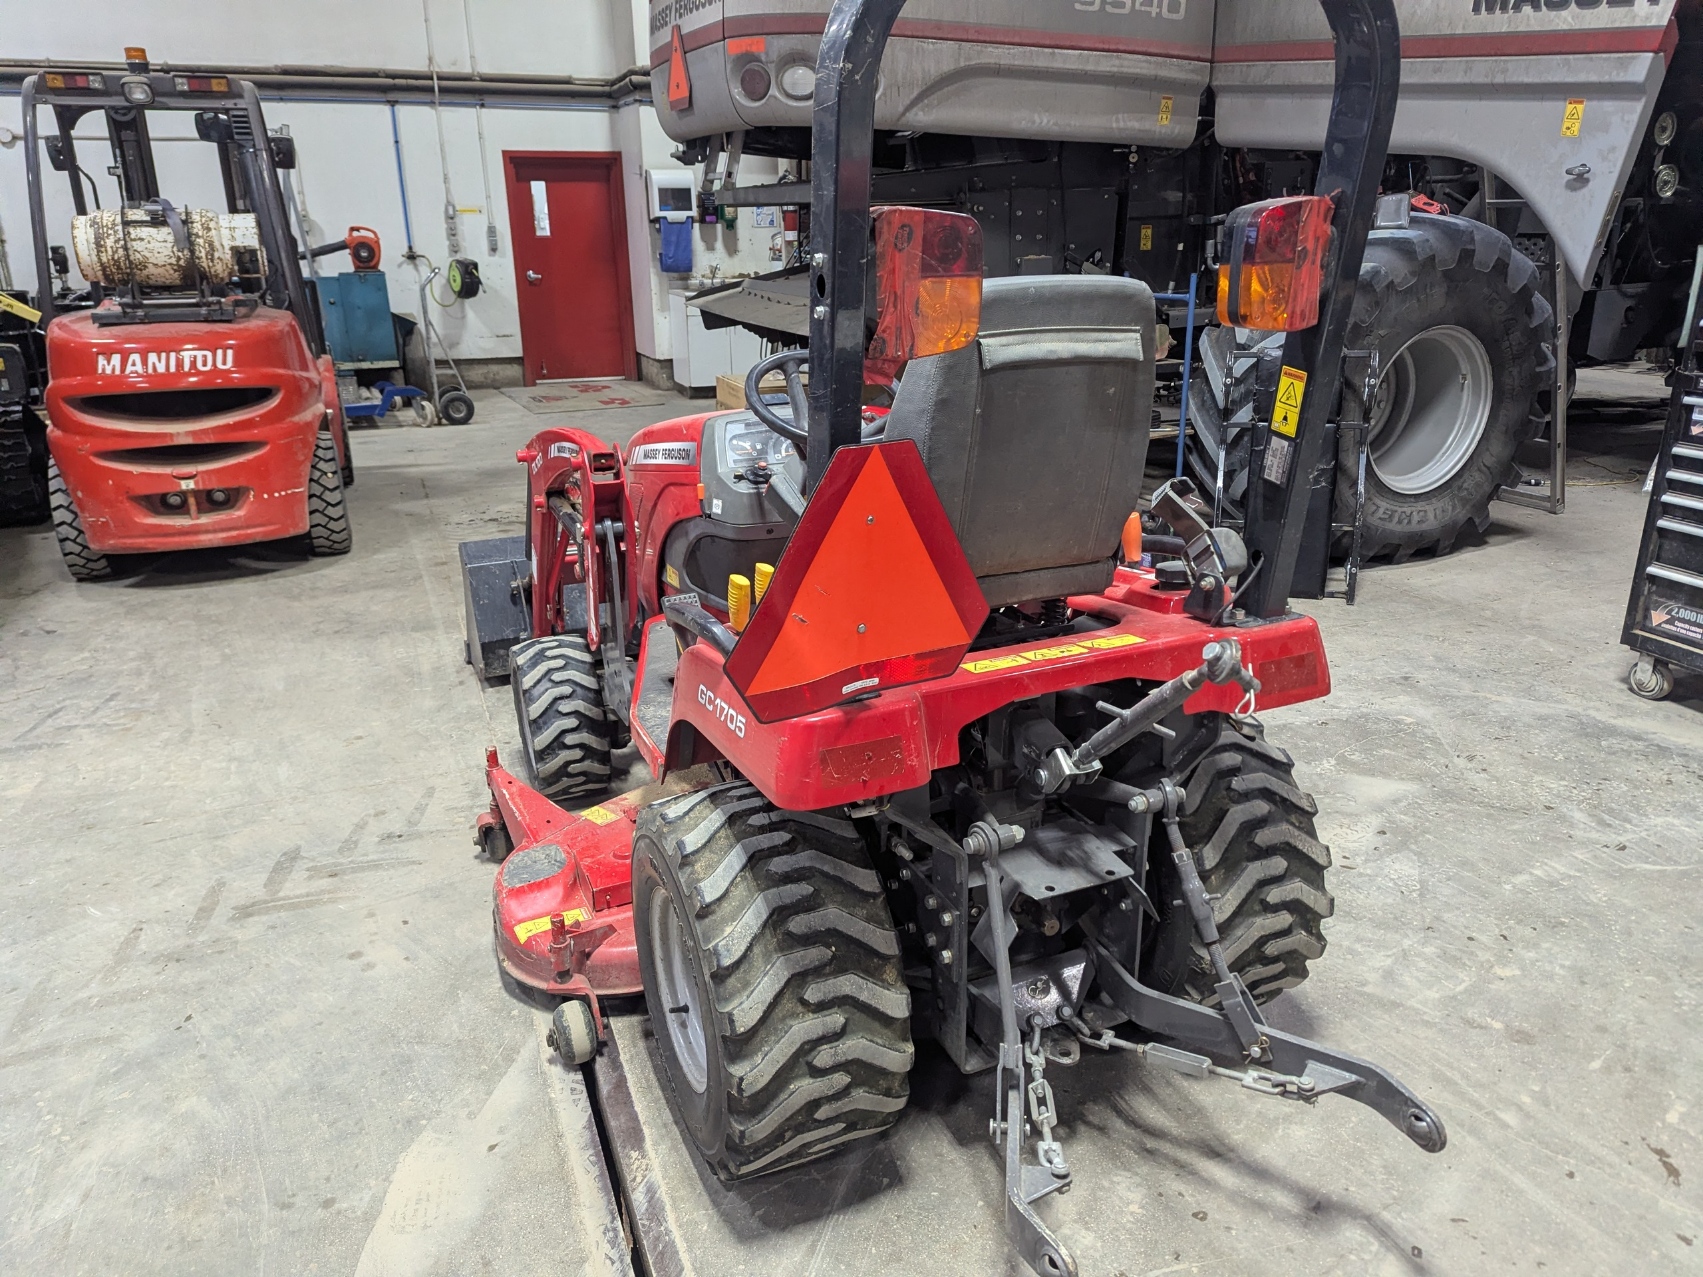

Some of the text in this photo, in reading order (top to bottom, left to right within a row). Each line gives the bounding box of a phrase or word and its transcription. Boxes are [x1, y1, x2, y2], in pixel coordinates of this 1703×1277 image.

[96, 348, 235, 376] MANITOU
[643, 447, 691, 461] MASSEY FERGUSON
[1672, 607, 1697, 621] 2,000
[698, 683, 747, 739] GC1705
